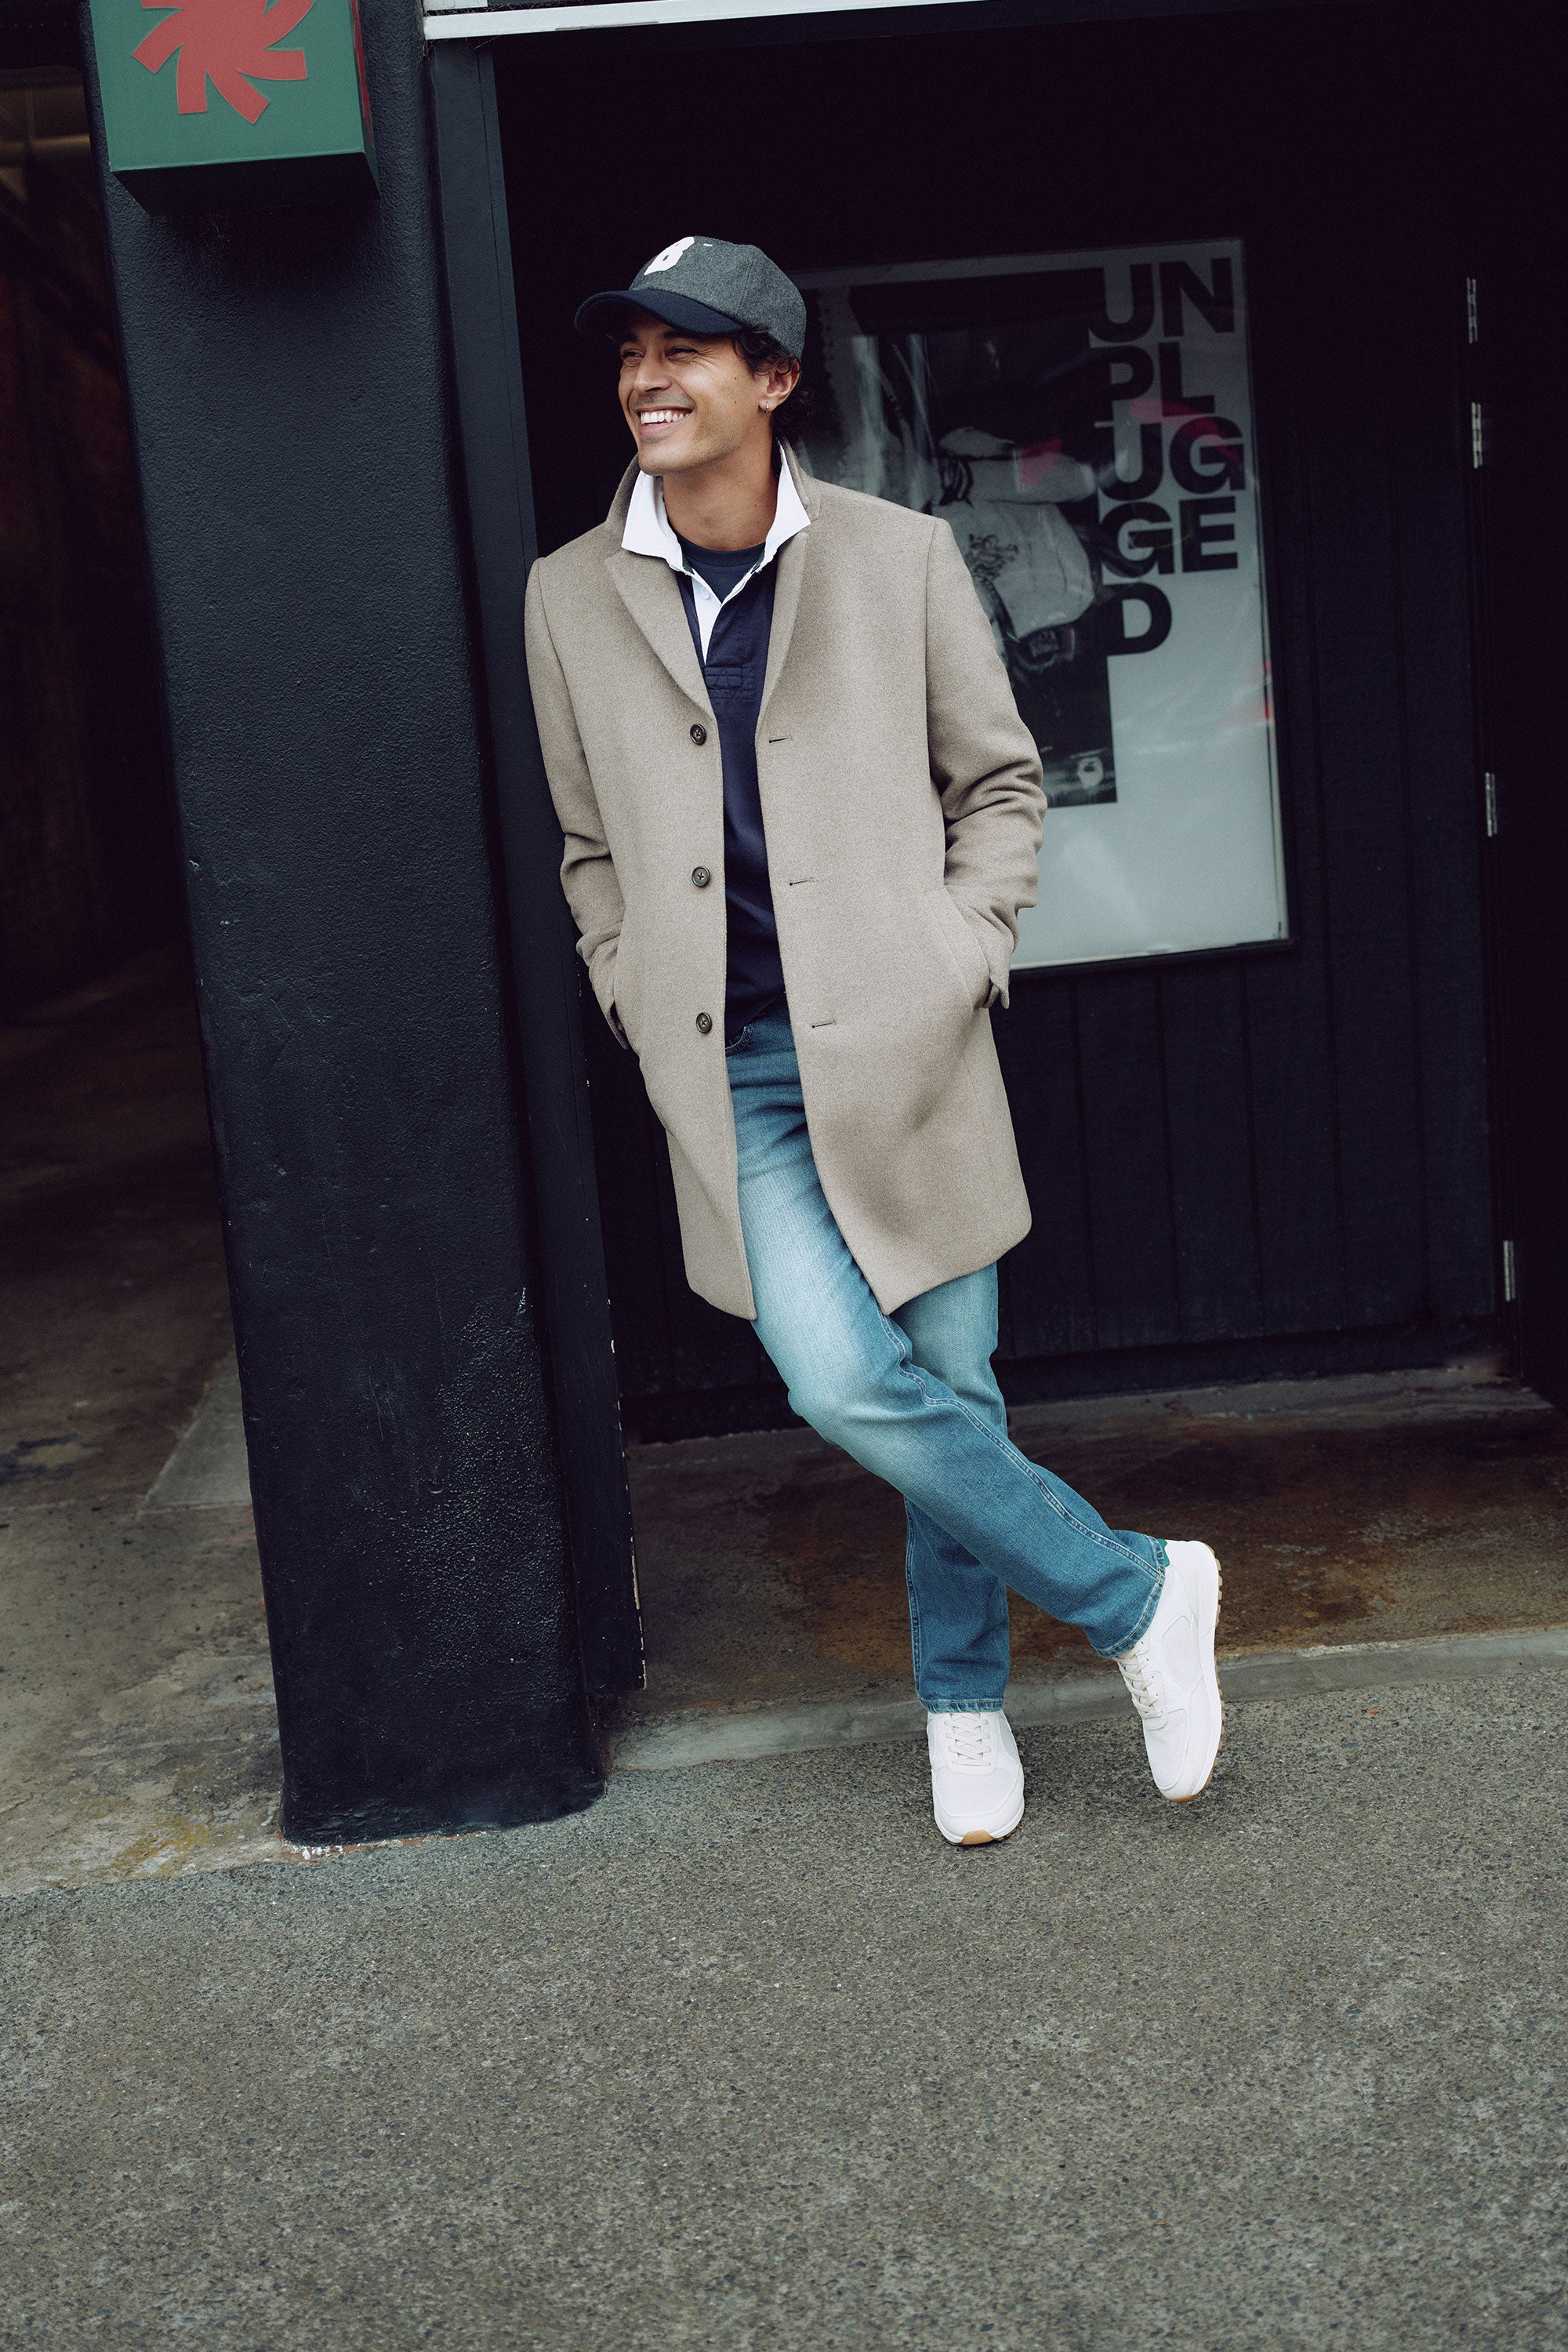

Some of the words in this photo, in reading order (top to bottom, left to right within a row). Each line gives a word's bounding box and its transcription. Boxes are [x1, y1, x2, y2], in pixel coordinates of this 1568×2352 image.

[1083, 257, 1235, 343] UN
[1089, 343, 1214, 421] PL
[1093, 416, 1245, 501] UG
[1098, 496, 1238, 578] GE
[1102, 582, 1171, 655] D
